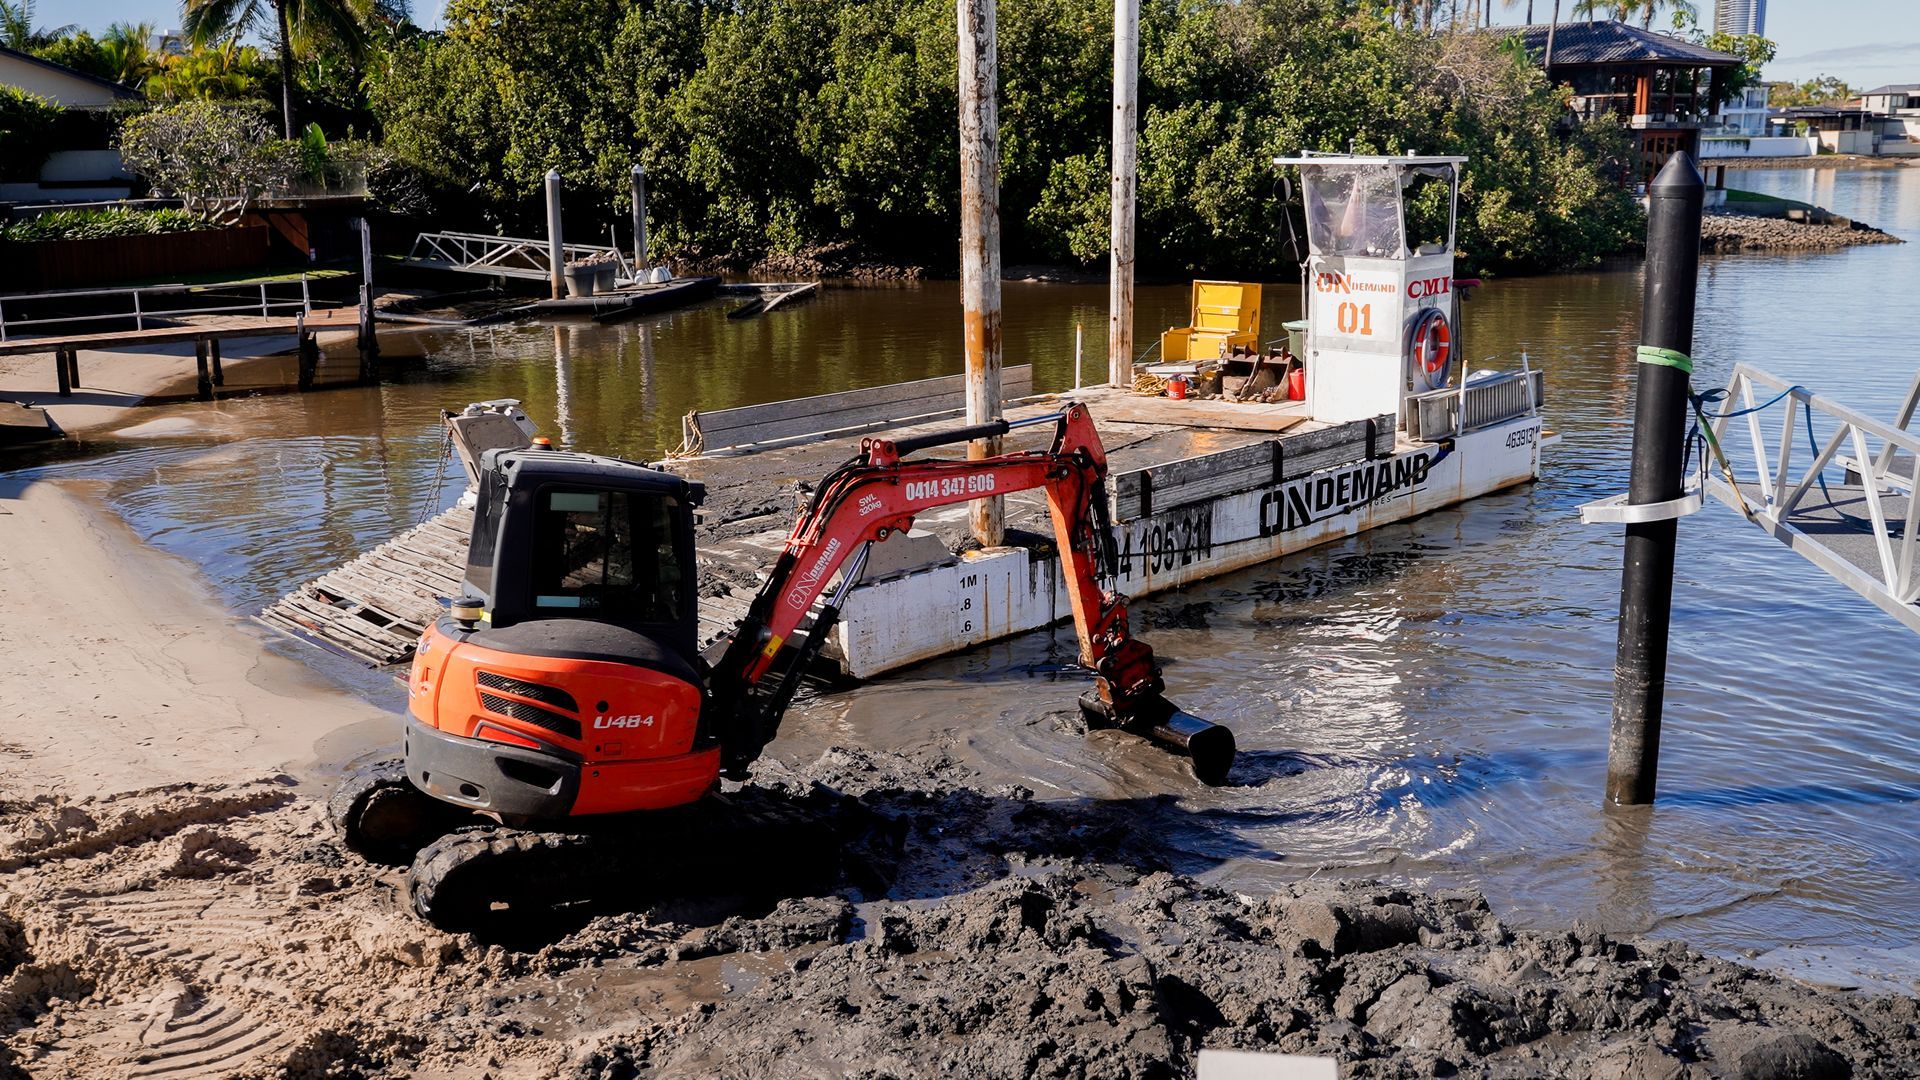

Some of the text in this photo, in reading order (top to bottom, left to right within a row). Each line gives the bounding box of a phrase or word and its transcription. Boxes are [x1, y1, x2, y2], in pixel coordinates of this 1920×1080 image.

[1407, 276, 1450, 299] CMI
[1337, 302, 1372, 335] 01
[906, 480, 939, 501] 0414
[941, 477, 965, 497] 347
[859, 493, 877, 507] SWL
[859, 500, 882, 516] 320kg
[1140, 522, 1175, 578] 195
[960, 574, 977, 589] 1M
[960, 598, 971, 611] .8
[960, 620, 972, 633] .6
